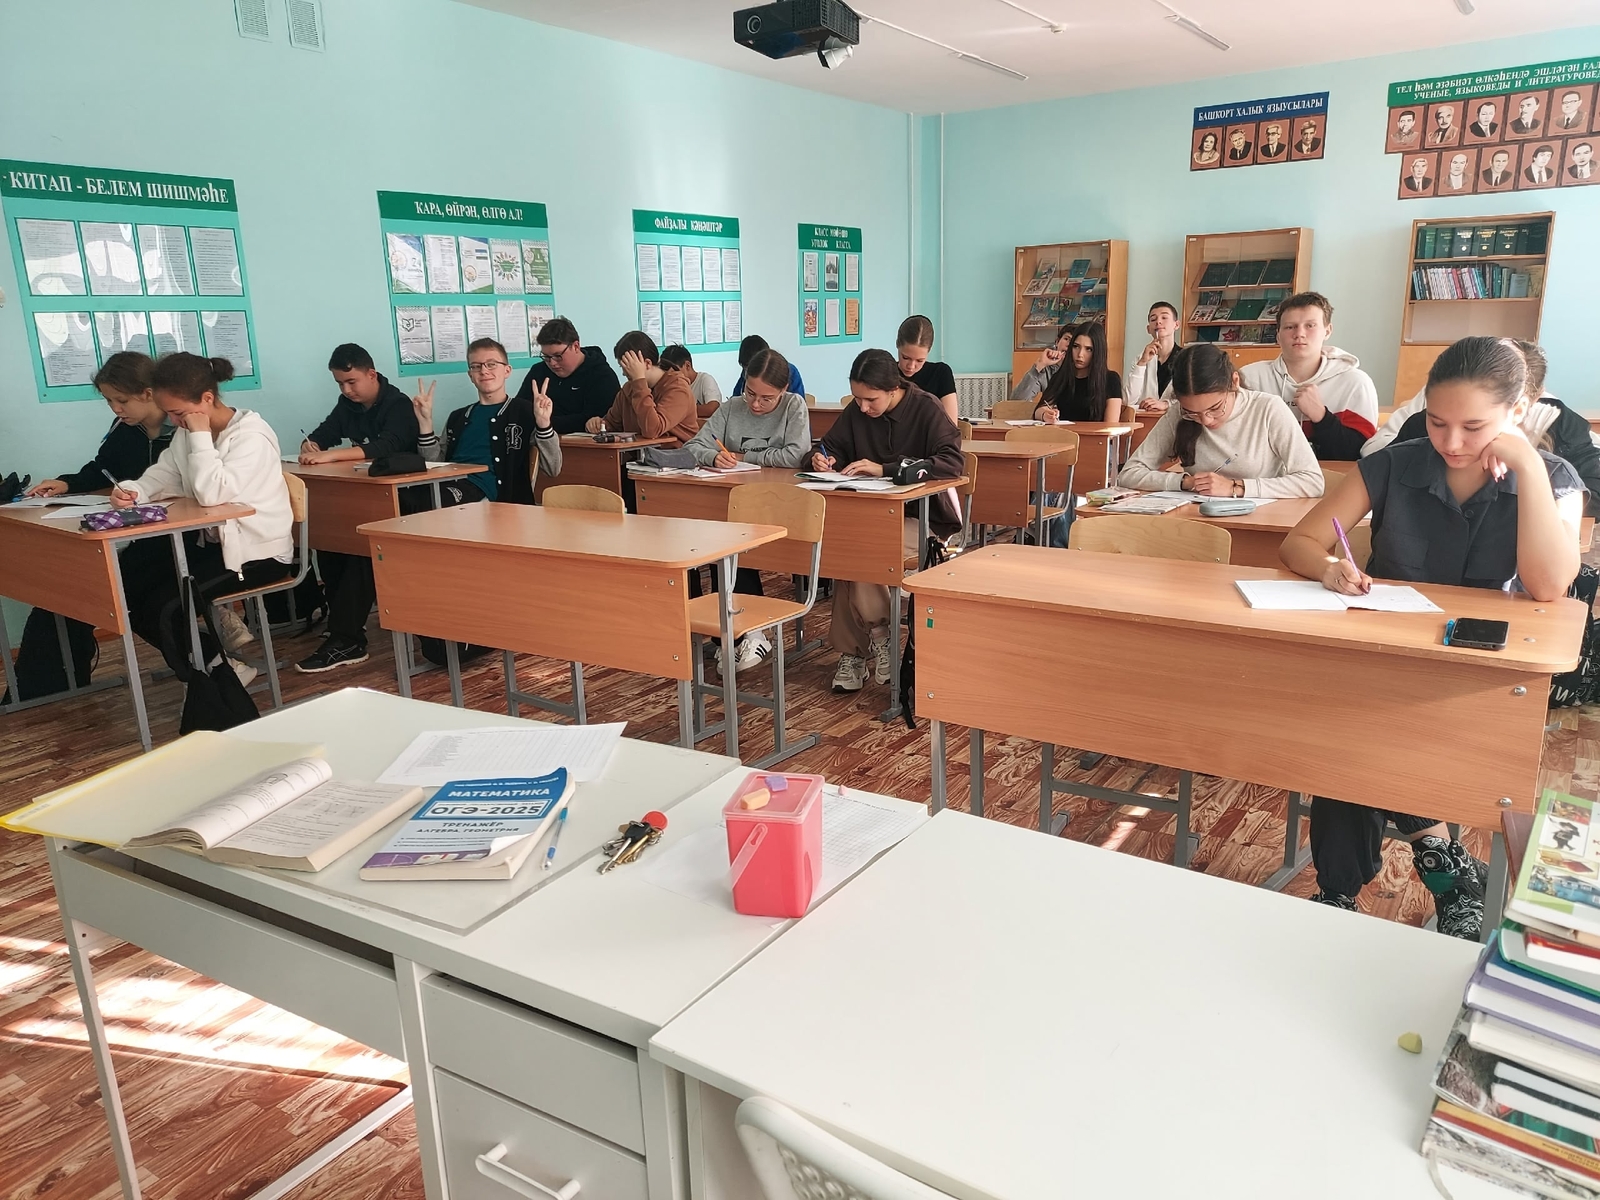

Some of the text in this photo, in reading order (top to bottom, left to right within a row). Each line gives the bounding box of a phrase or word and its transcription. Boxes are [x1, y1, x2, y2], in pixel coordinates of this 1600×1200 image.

[1396, 85, 1413, 94] ТЕЛ
[1533, 63, 1580, 77] ЭШЛӘГӘН
[1414, 88, 1452, 100] УЧЕНЫЕ,
[1454, 81, 1511, 96] ЯЗЫКОВЕДЫ
[1514, 79, 1522, 88] И
[9, 171, 74, 193] КИТАП
[84, 177, 143, 198] БЕЛЕМ
[445, 201, 481, 220] ӨЙРӘН,
[481, 206, 507, 220] ӨЛГӨ
[508, 208, 524, 221] АЛ!
[447, 788, 551, 798] МАТЕМАТИКА
[430, 806, 542, 815] ОГЭ-2025
